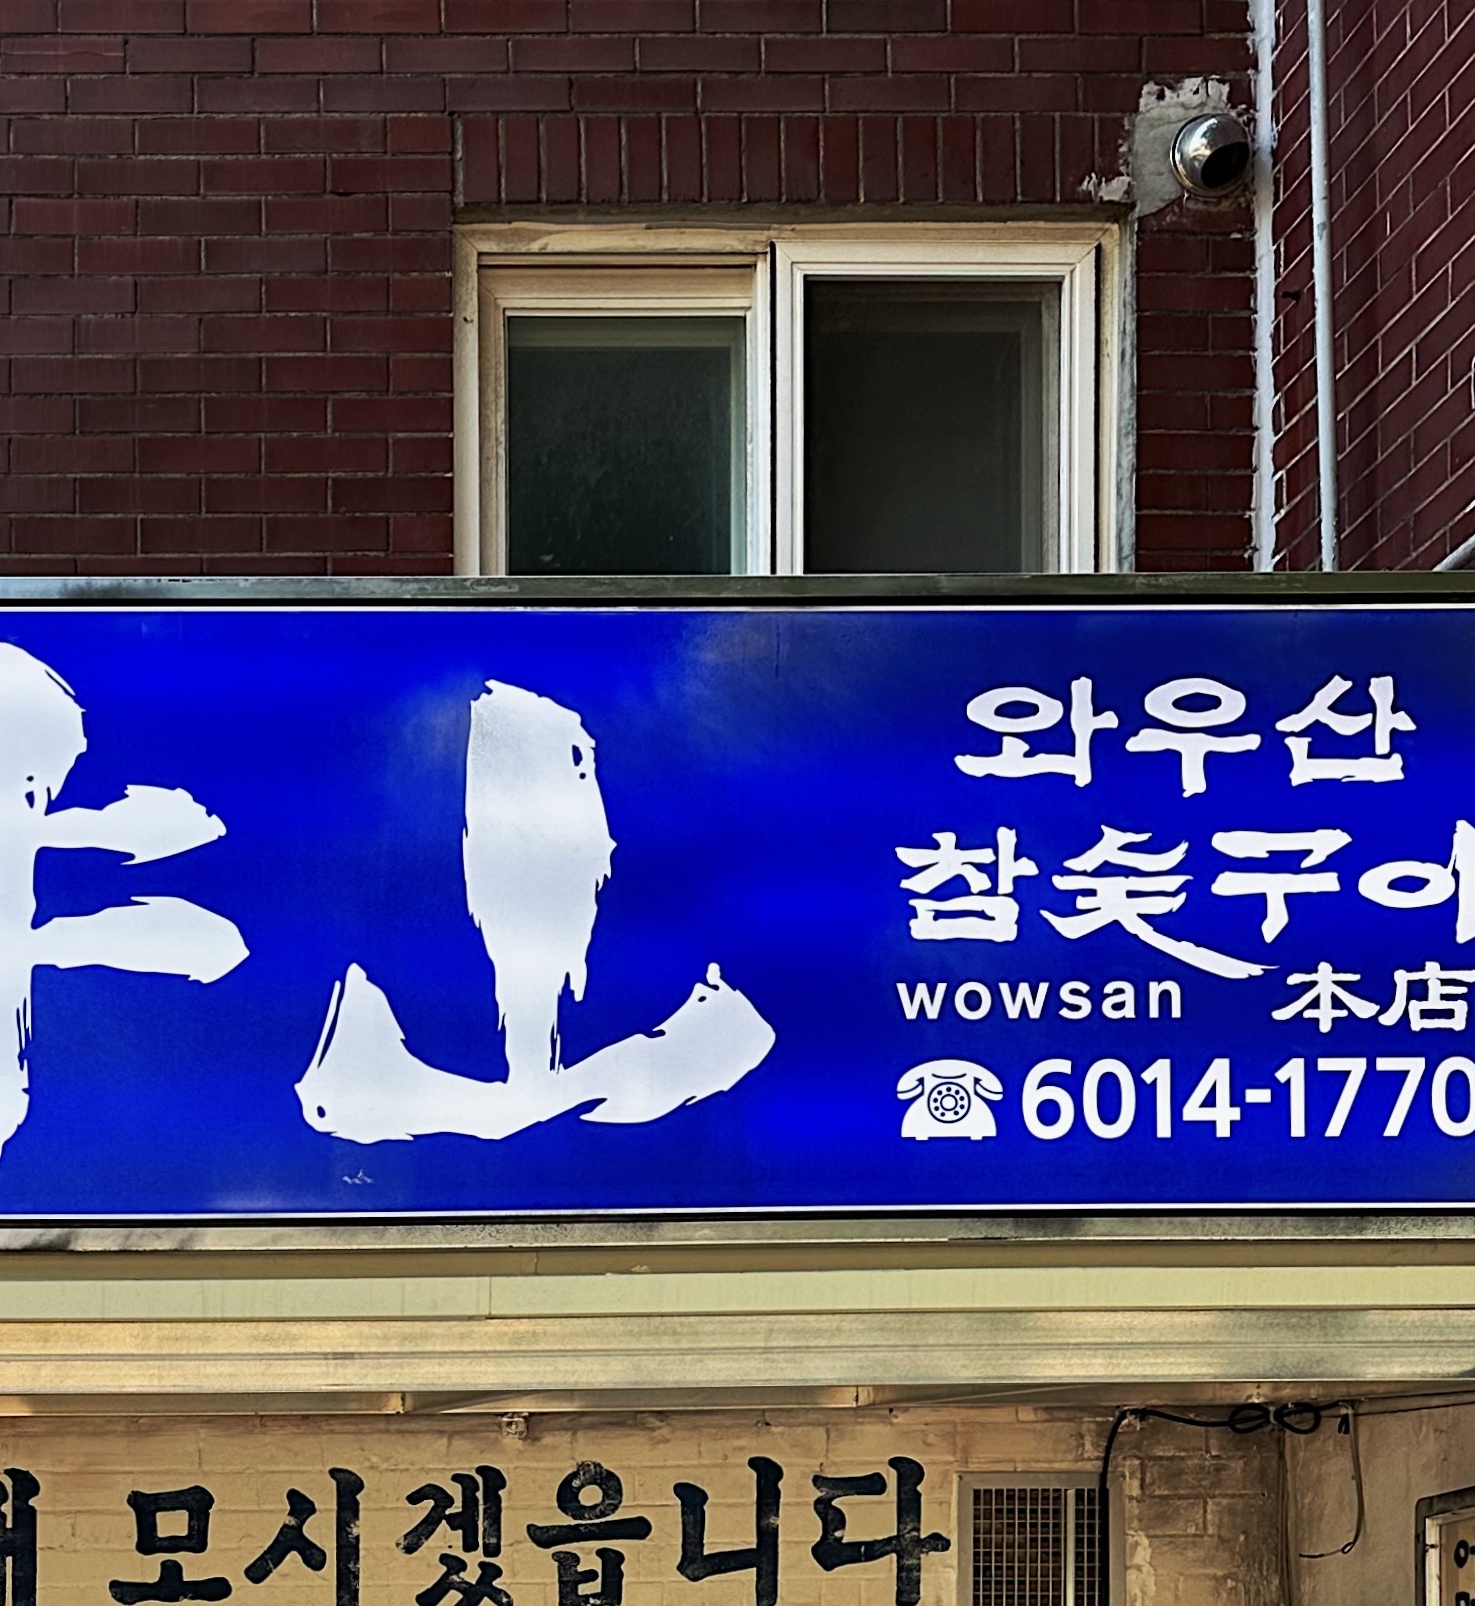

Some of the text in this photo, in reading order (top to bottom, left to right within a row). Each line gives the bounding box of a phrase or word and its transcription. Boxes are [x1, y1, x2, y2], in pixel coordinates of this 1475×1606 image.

[954, 675, 1417, 797] 와우산
[896, 981, 1182, 1020] wowsan
[1272, 961, 1475, 1033] 本店
[1022, 1057, 1475, 1140] 6014-1770
